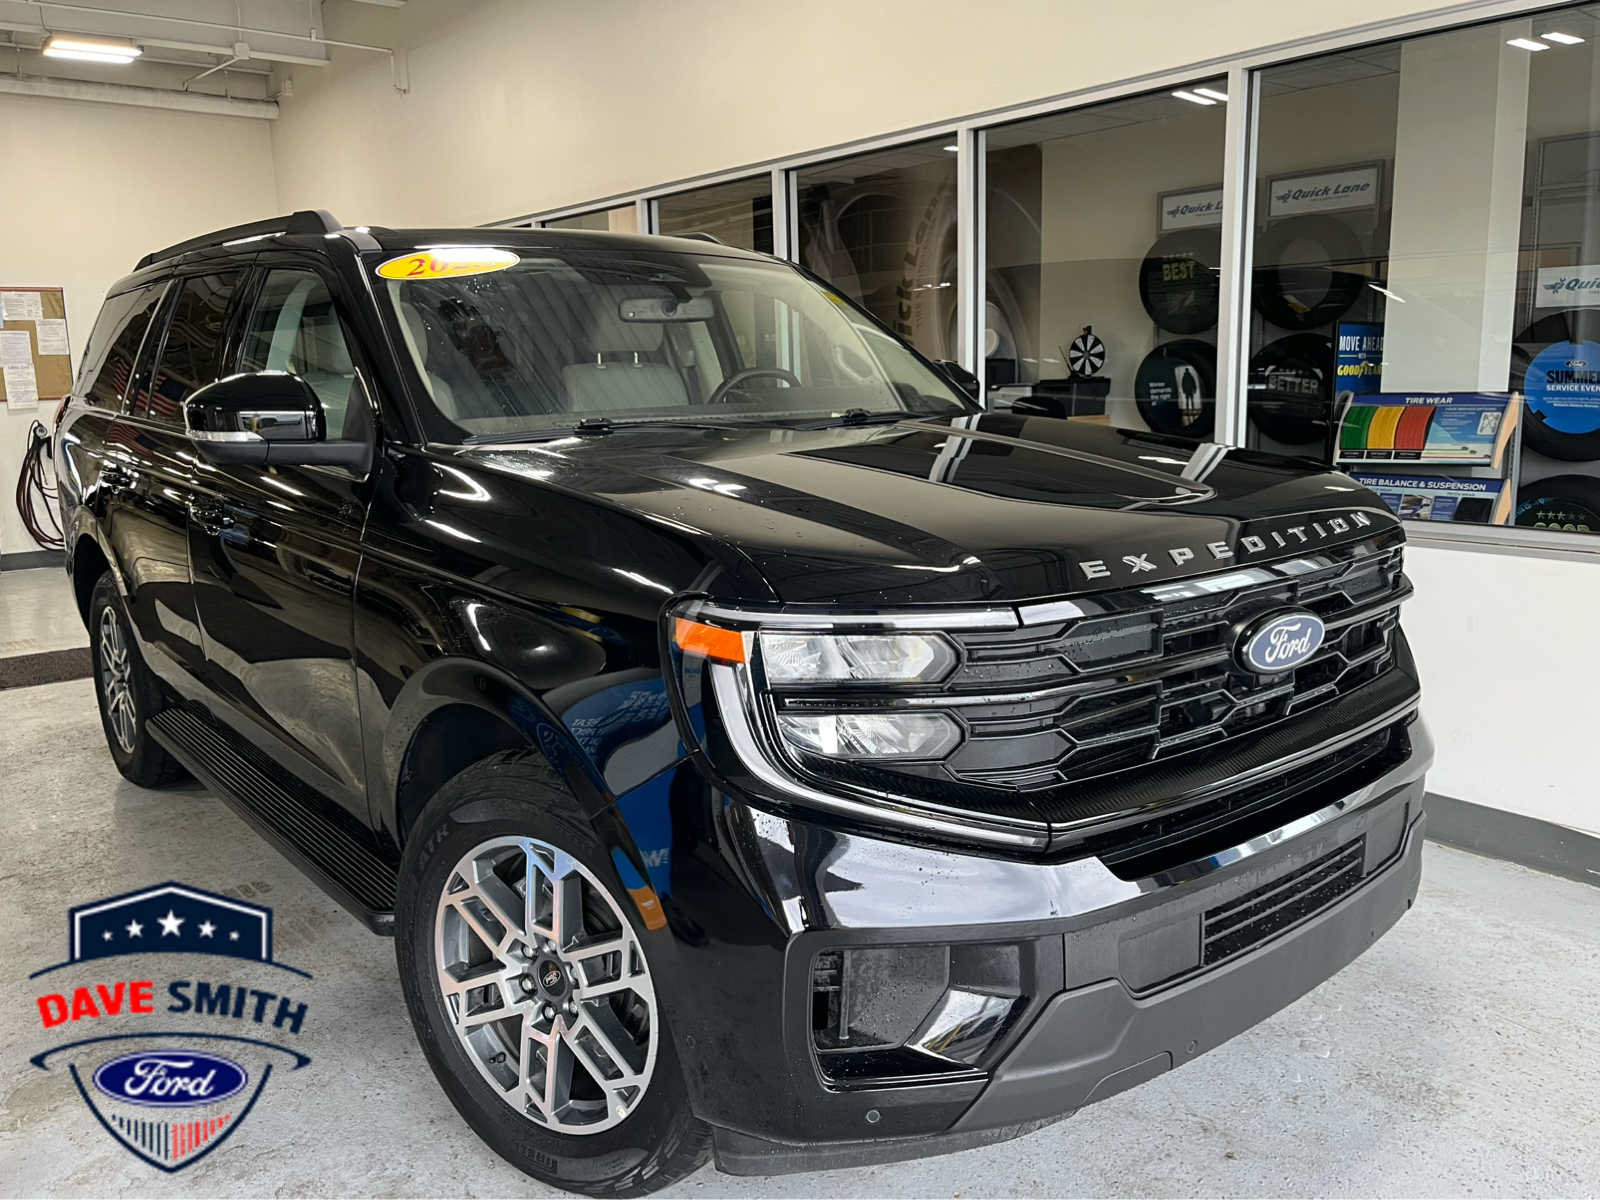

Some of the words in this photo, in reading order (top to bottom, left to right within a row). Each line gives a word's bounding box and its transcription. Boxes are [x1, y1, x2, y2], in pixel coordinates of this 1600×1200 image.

[1292, 185, 1331, 200] Quick
[1333, 183, 1370, 195] Lane
[1180, 201, 1215, 215] Quick
[1162, 261, 1195, 281] BEST
[1339, 336, 1361, 352] MOVE
[1268, 375, 1320, 394] BETTER
[1546, 384, 1579, 392] SERVICE
[1359, 477, 1378, 486] TIRE
[1378, 478, 1420, 488] BALANCE
[1420, 480, 1427, 488] &
[1427, 481, 1487, 491] SUSPENSION
[1079, 511, 1372, 581] EXPEDITION
[1264, 622, 1312, 664] Ford
